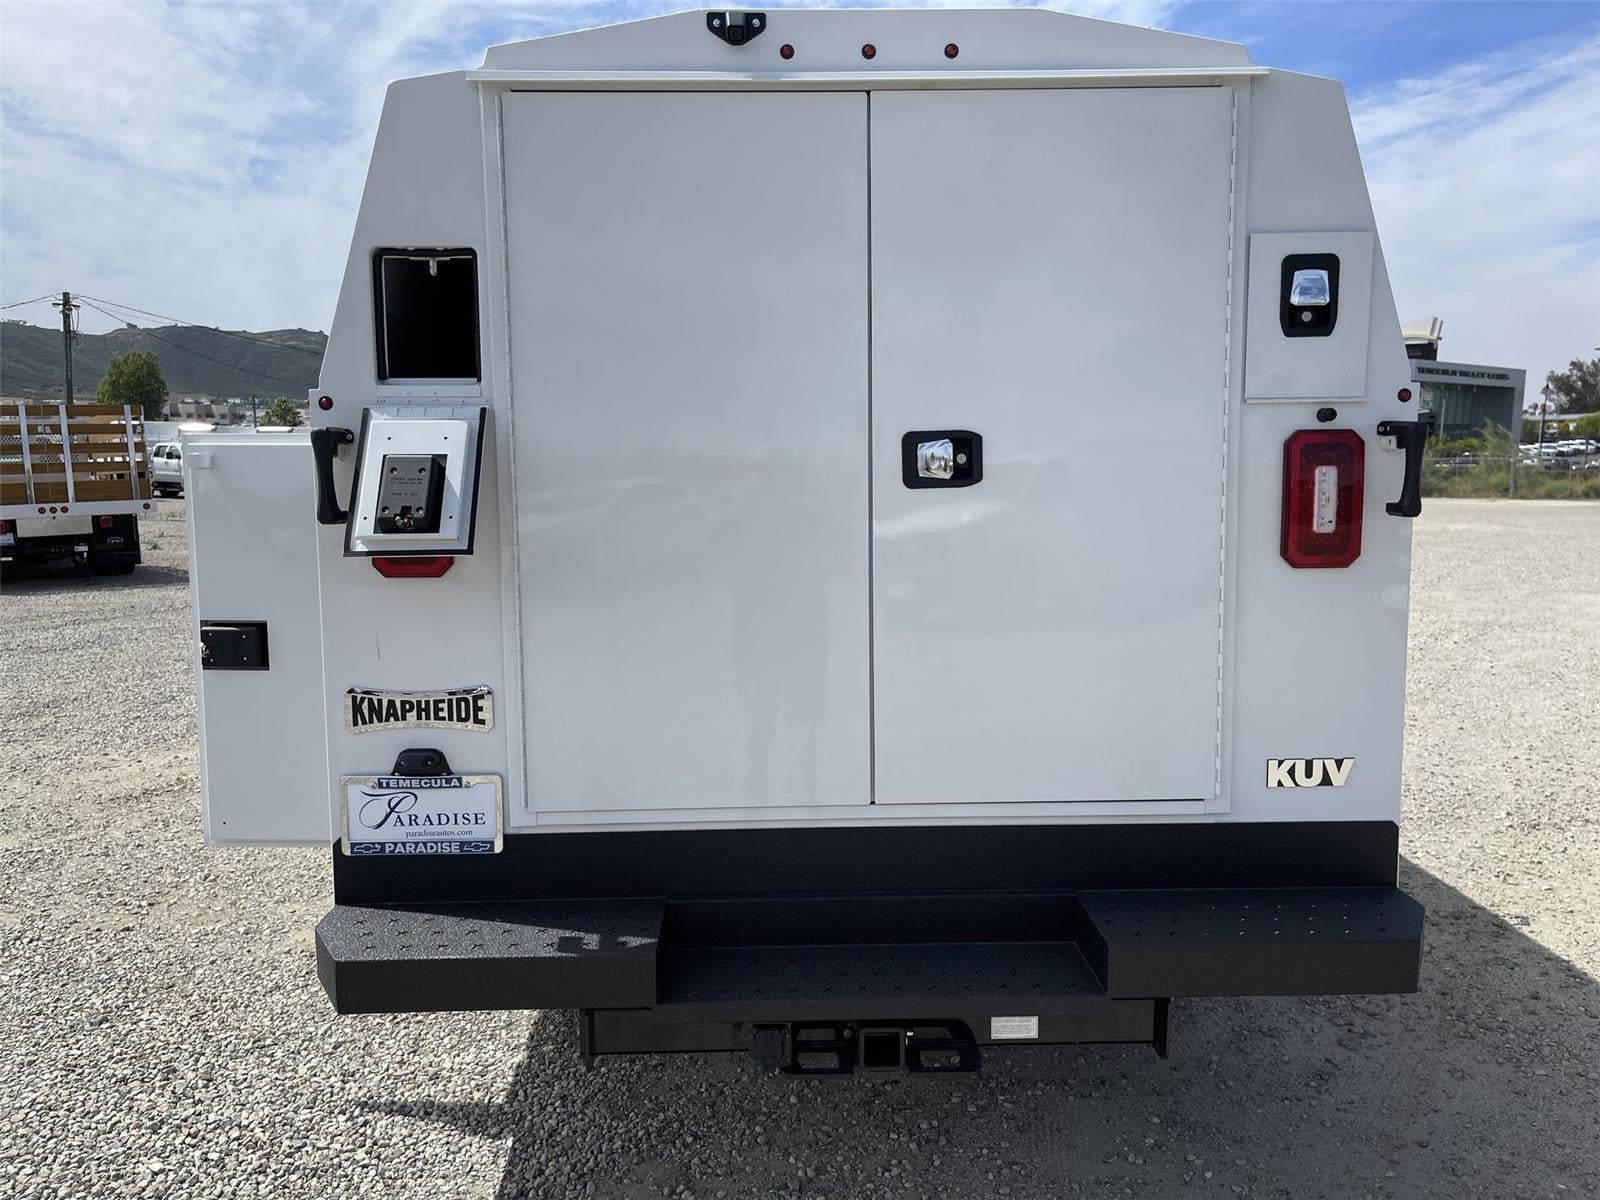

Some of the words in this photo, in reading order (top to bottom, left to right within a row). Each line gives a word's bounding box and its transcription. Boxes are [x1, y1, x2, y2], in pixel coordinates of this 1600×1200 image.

[351, 693, 486, 727] KNAPHEIDE
[379, 778, 461, 788] TEMECULA
[1266, 757, 1355, 788] KUV
[358, 790, 486, 830] PARADISE
[405, 829, 473, 838] paradiseautos.com
[385, 842, 461, 853] PARADISE
